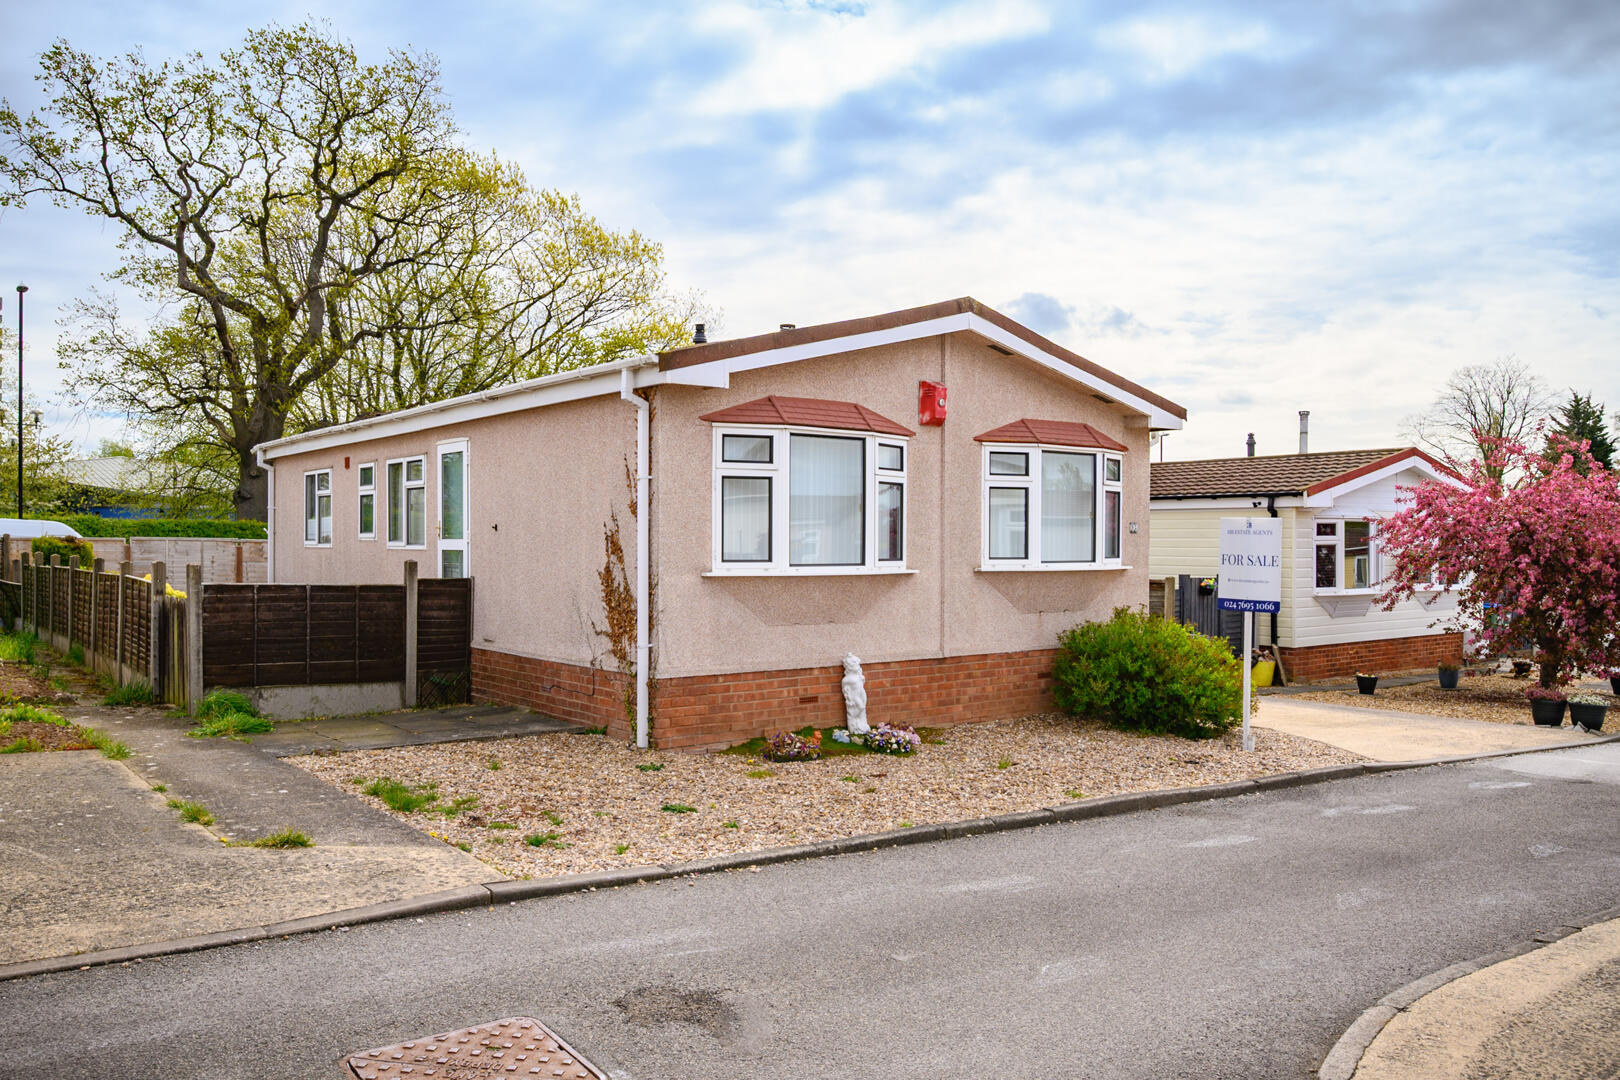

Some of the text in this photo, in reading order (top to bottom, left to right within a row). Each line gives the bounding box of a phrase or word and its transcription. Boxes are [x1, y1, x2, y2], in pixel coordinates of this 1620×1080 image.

[1221, 553, 1279, 567] FOR SALE
[1224, 600, 1275, 611] 024 7695 1066
